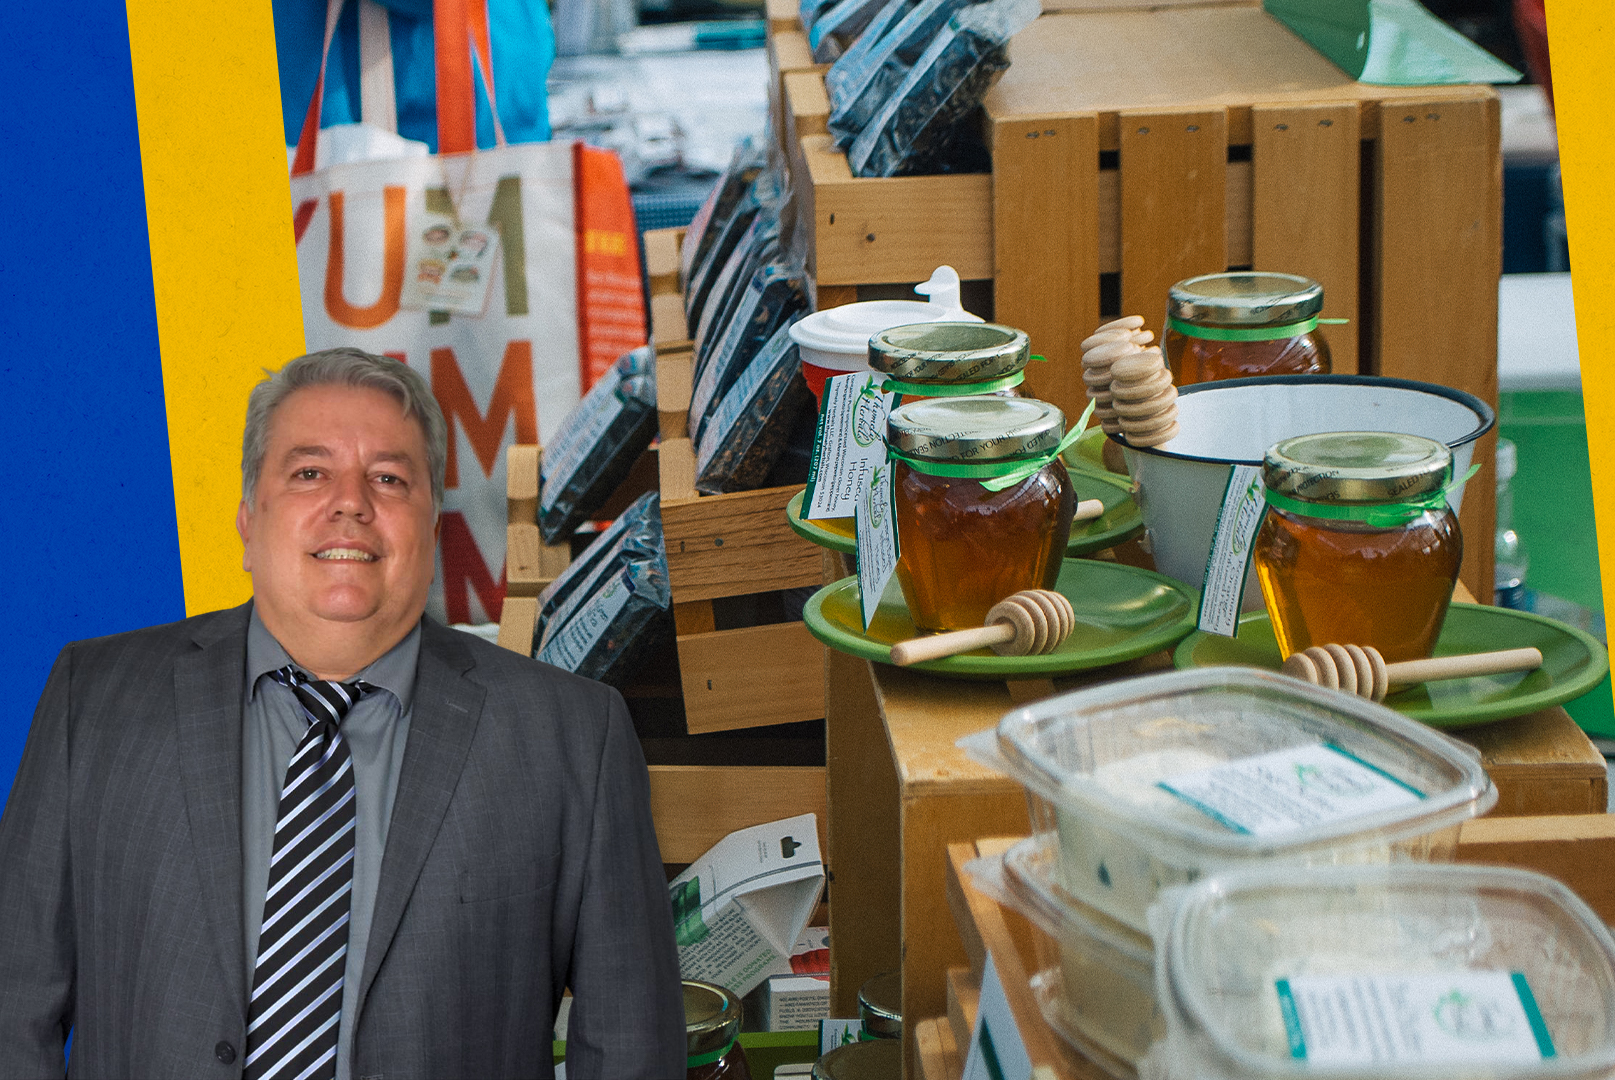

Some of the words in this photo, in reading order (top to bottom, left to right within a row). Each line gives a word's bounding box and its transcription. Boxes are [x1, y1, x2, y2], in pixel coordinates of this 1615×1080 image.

[857, 397, 871, 441] Herbals
[959, 447, 979, 460] FOR
[980, 435, 1009, 450] YOUR
[821, 463, 829, 490] Wisconsin
[841, 461, 857, 501] Honey
[1387, 474, 1419, 499] SEALED
